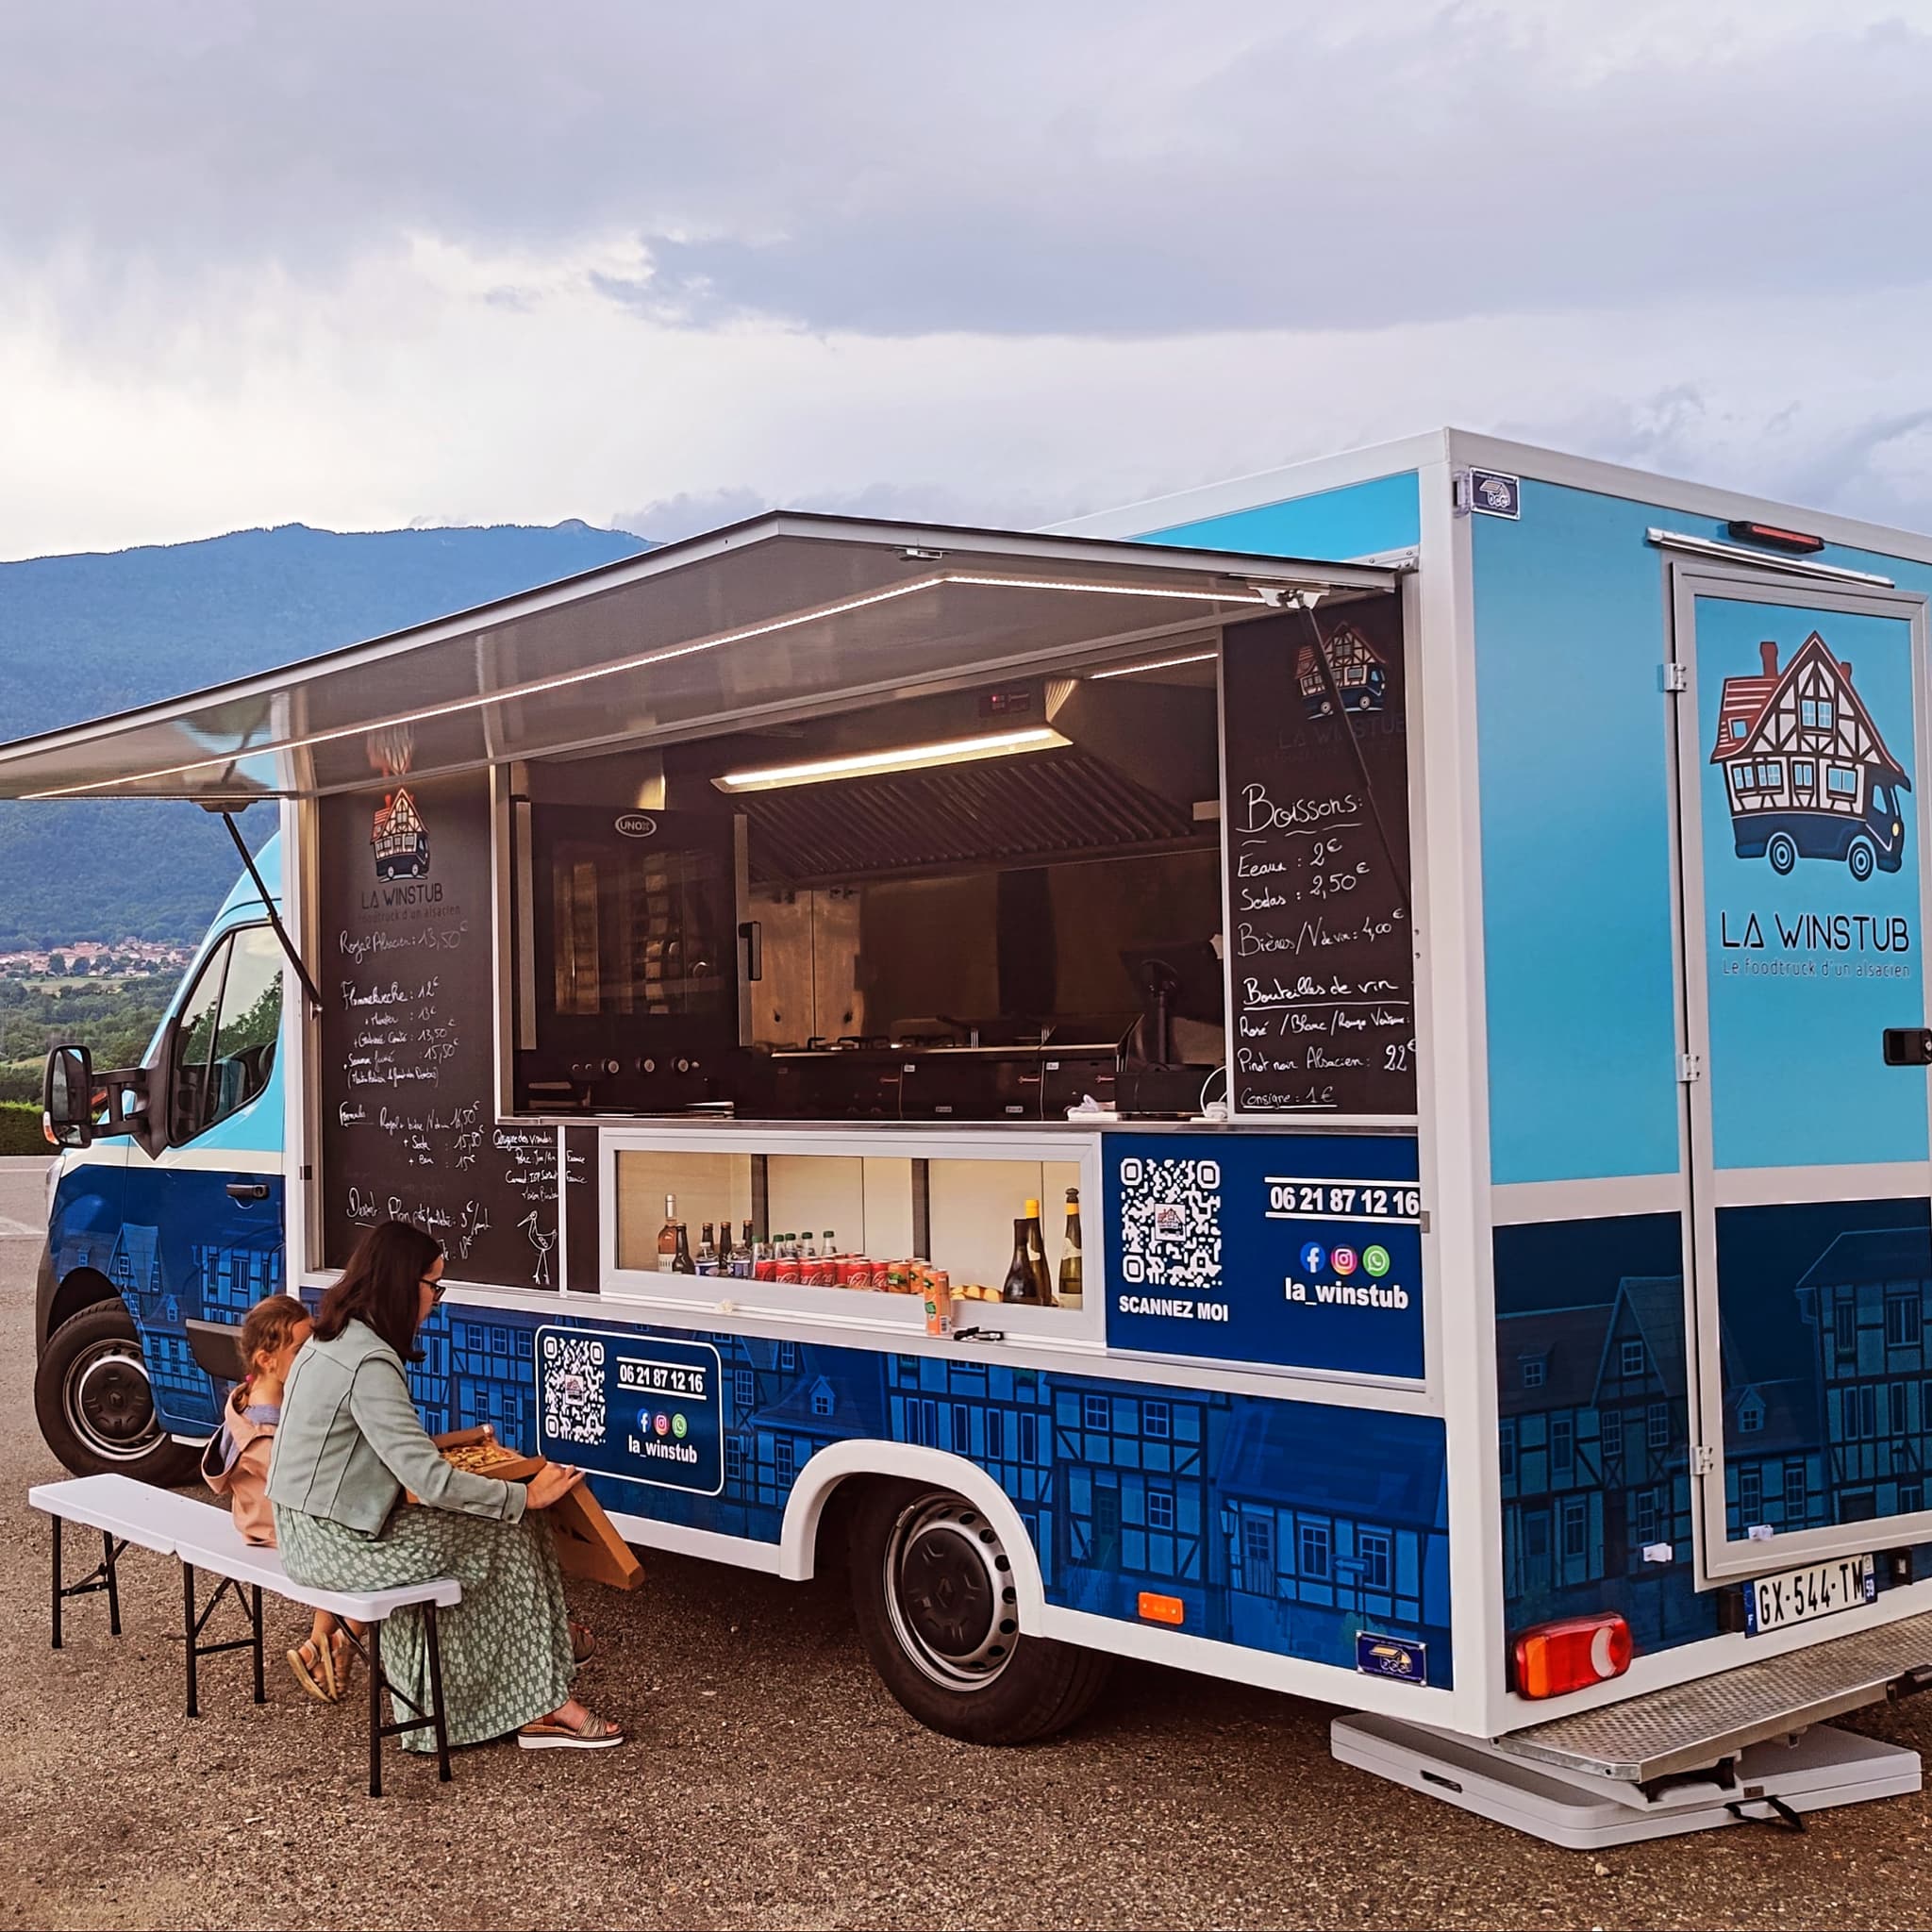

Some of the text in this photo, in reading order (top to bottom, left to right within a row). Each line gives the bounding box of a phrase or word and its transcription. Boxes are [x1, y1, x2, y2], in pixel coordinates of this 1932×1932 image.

[362, 883, 443, 909] LA WINSTUB
[1240, 887, 1287, 911] Sodas
[1722, 912, 1910, 952] LA WINSTUB
[1723, 958, 1910, 977] Le foodtruck d'un alsacien
[1331, 975, 1351, 995] de
[1237, 1047, 1270, 1073] Pinot
[1271, 1187, 1420, 1216] 06 21 87 12 16
[1285, 1277, 1409, 1309] la_winstub
[1119, 1295, 1228, 1322] SCANNEZ MOI
[620, 1364, 703, 1392] 06 21 87 12 16
[628, 1434, 698, 1464] la_winstub
[1747, 1614, 1754, 1626] F
